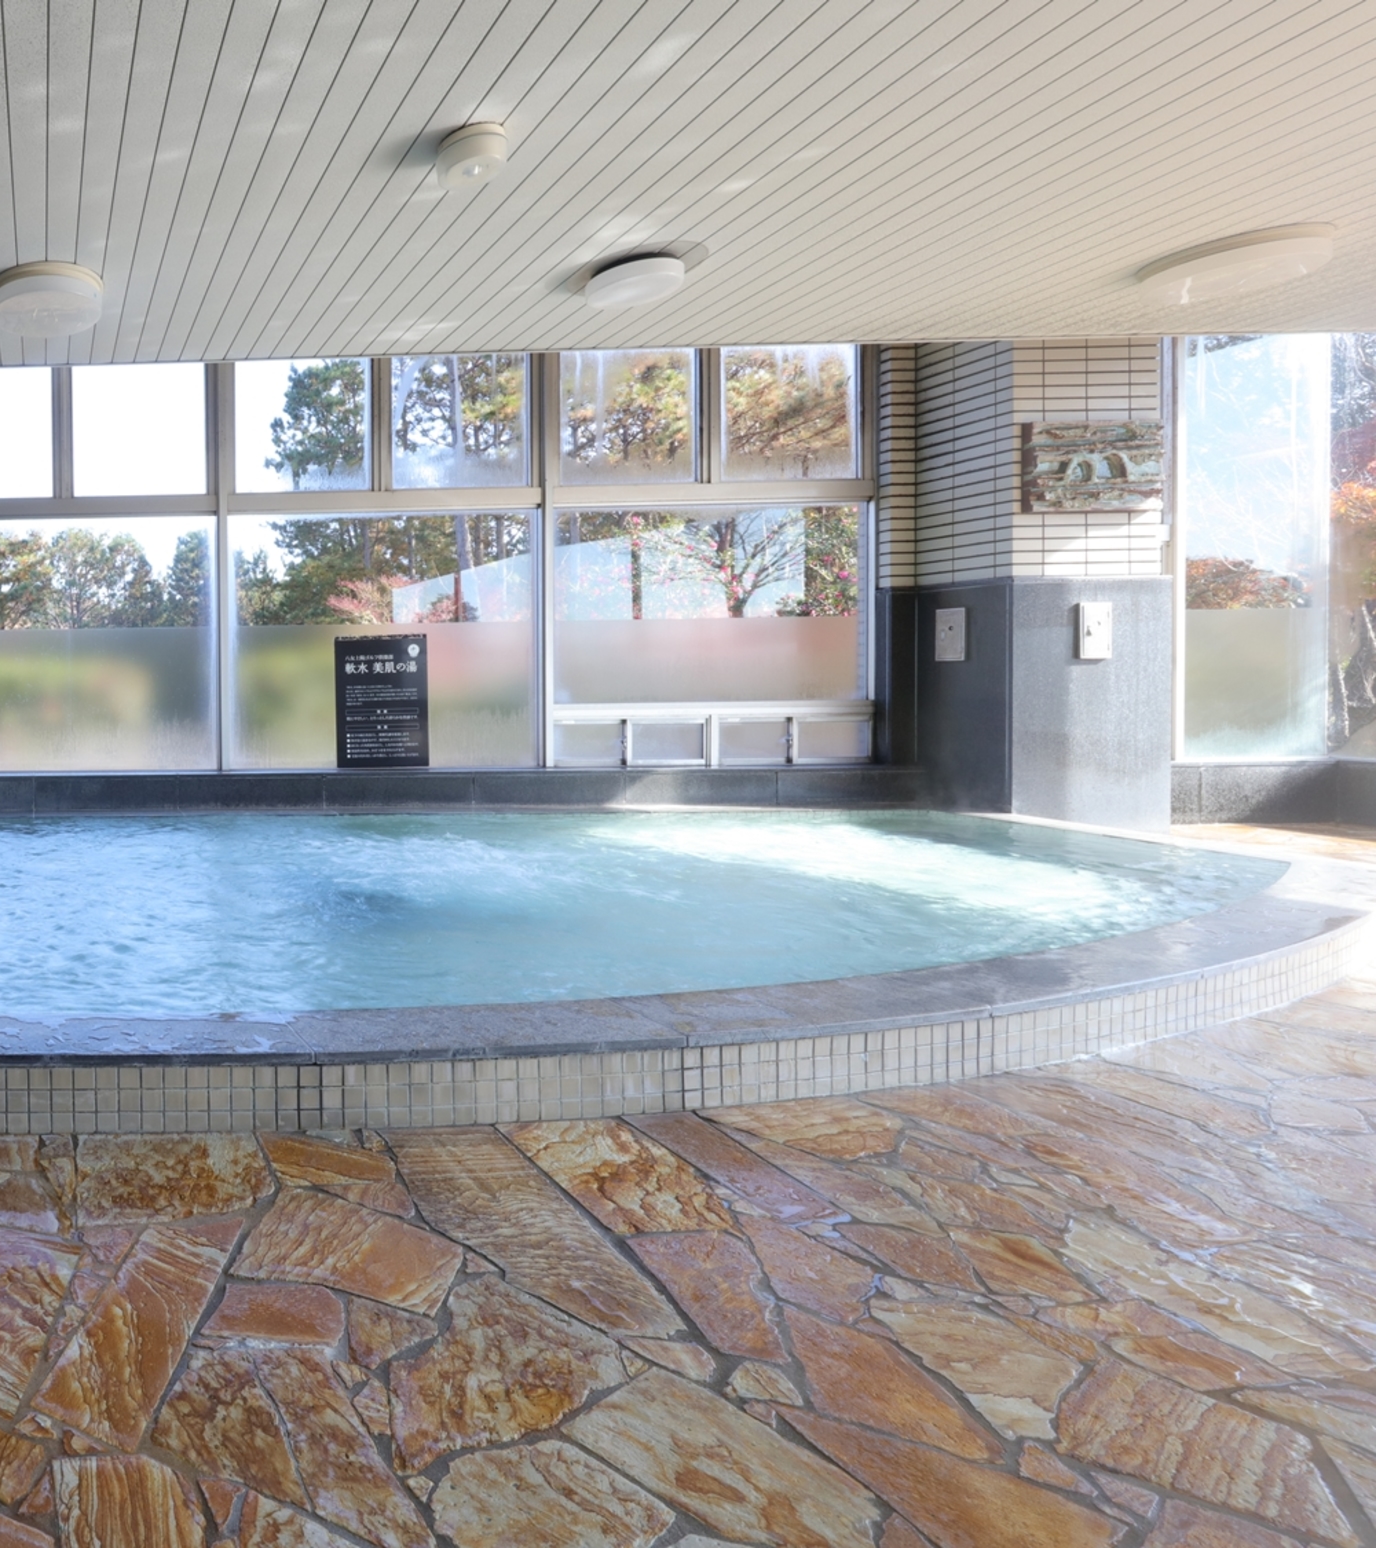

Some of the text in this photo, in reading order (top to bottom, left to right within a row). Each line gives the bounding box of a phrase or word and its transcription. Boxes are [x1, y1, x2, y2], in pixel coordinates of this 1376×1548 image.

[345, 661, 418, 674] 軟水 美肌の湯
